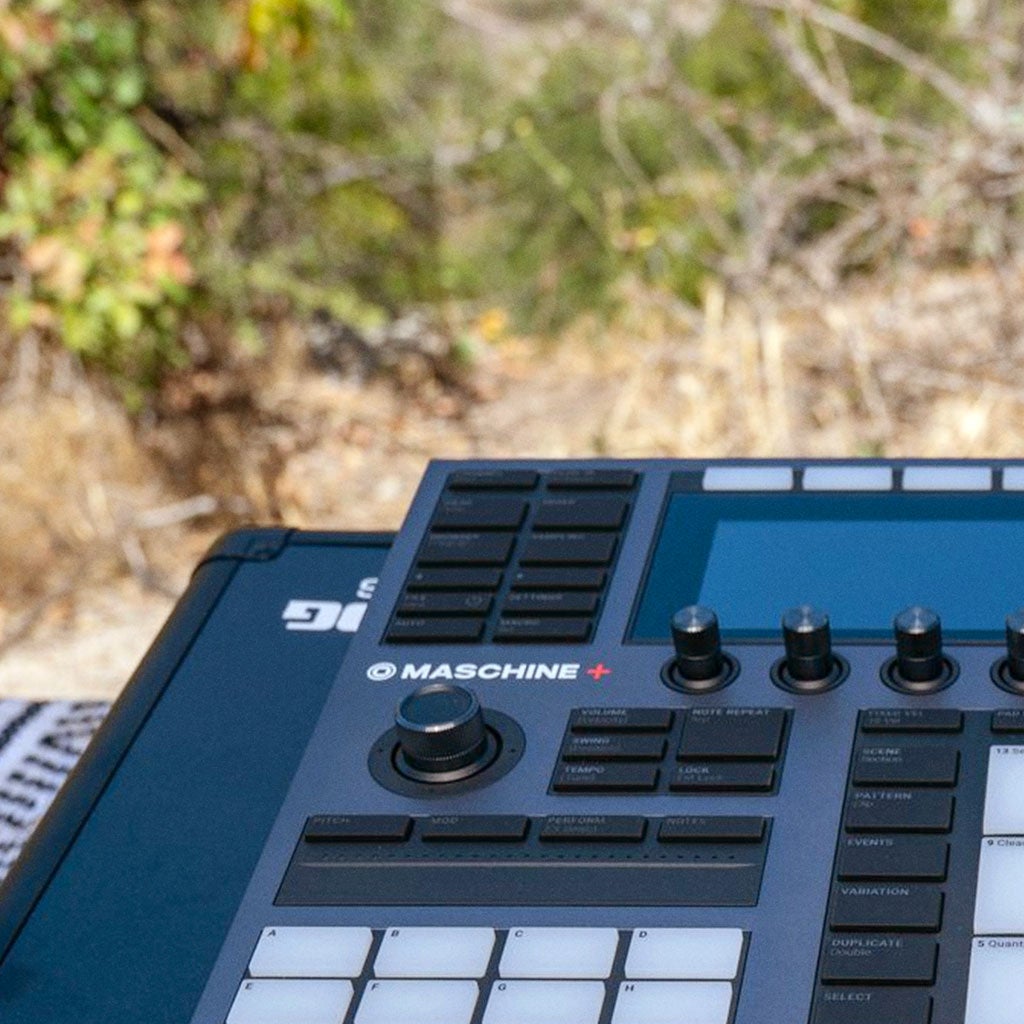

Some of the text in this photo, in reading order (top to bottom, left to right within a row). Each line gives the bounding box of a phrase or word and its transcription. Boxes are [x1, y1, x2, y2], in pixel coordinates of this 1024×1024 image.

[401, 662, 580, 681] MASCHINE
[692, 709, 770, 717] NOTE REPEAT
[564, 766, 606, 774] TEMPO
[679, 766, 709, 774] LOCK
[855, 792, 912, 800] PATTERN
[848, 838, 893, 846] EVENTS
[987, 839, 994, 847] 9
[841, 888, 910, 896] VARIATION
[268, 929, 277, 937] A
[832, 939, 903, 947] DUPLICATE
[978, 940, 985, 948] 5
[824, 993, 871, 1001] SELECT
